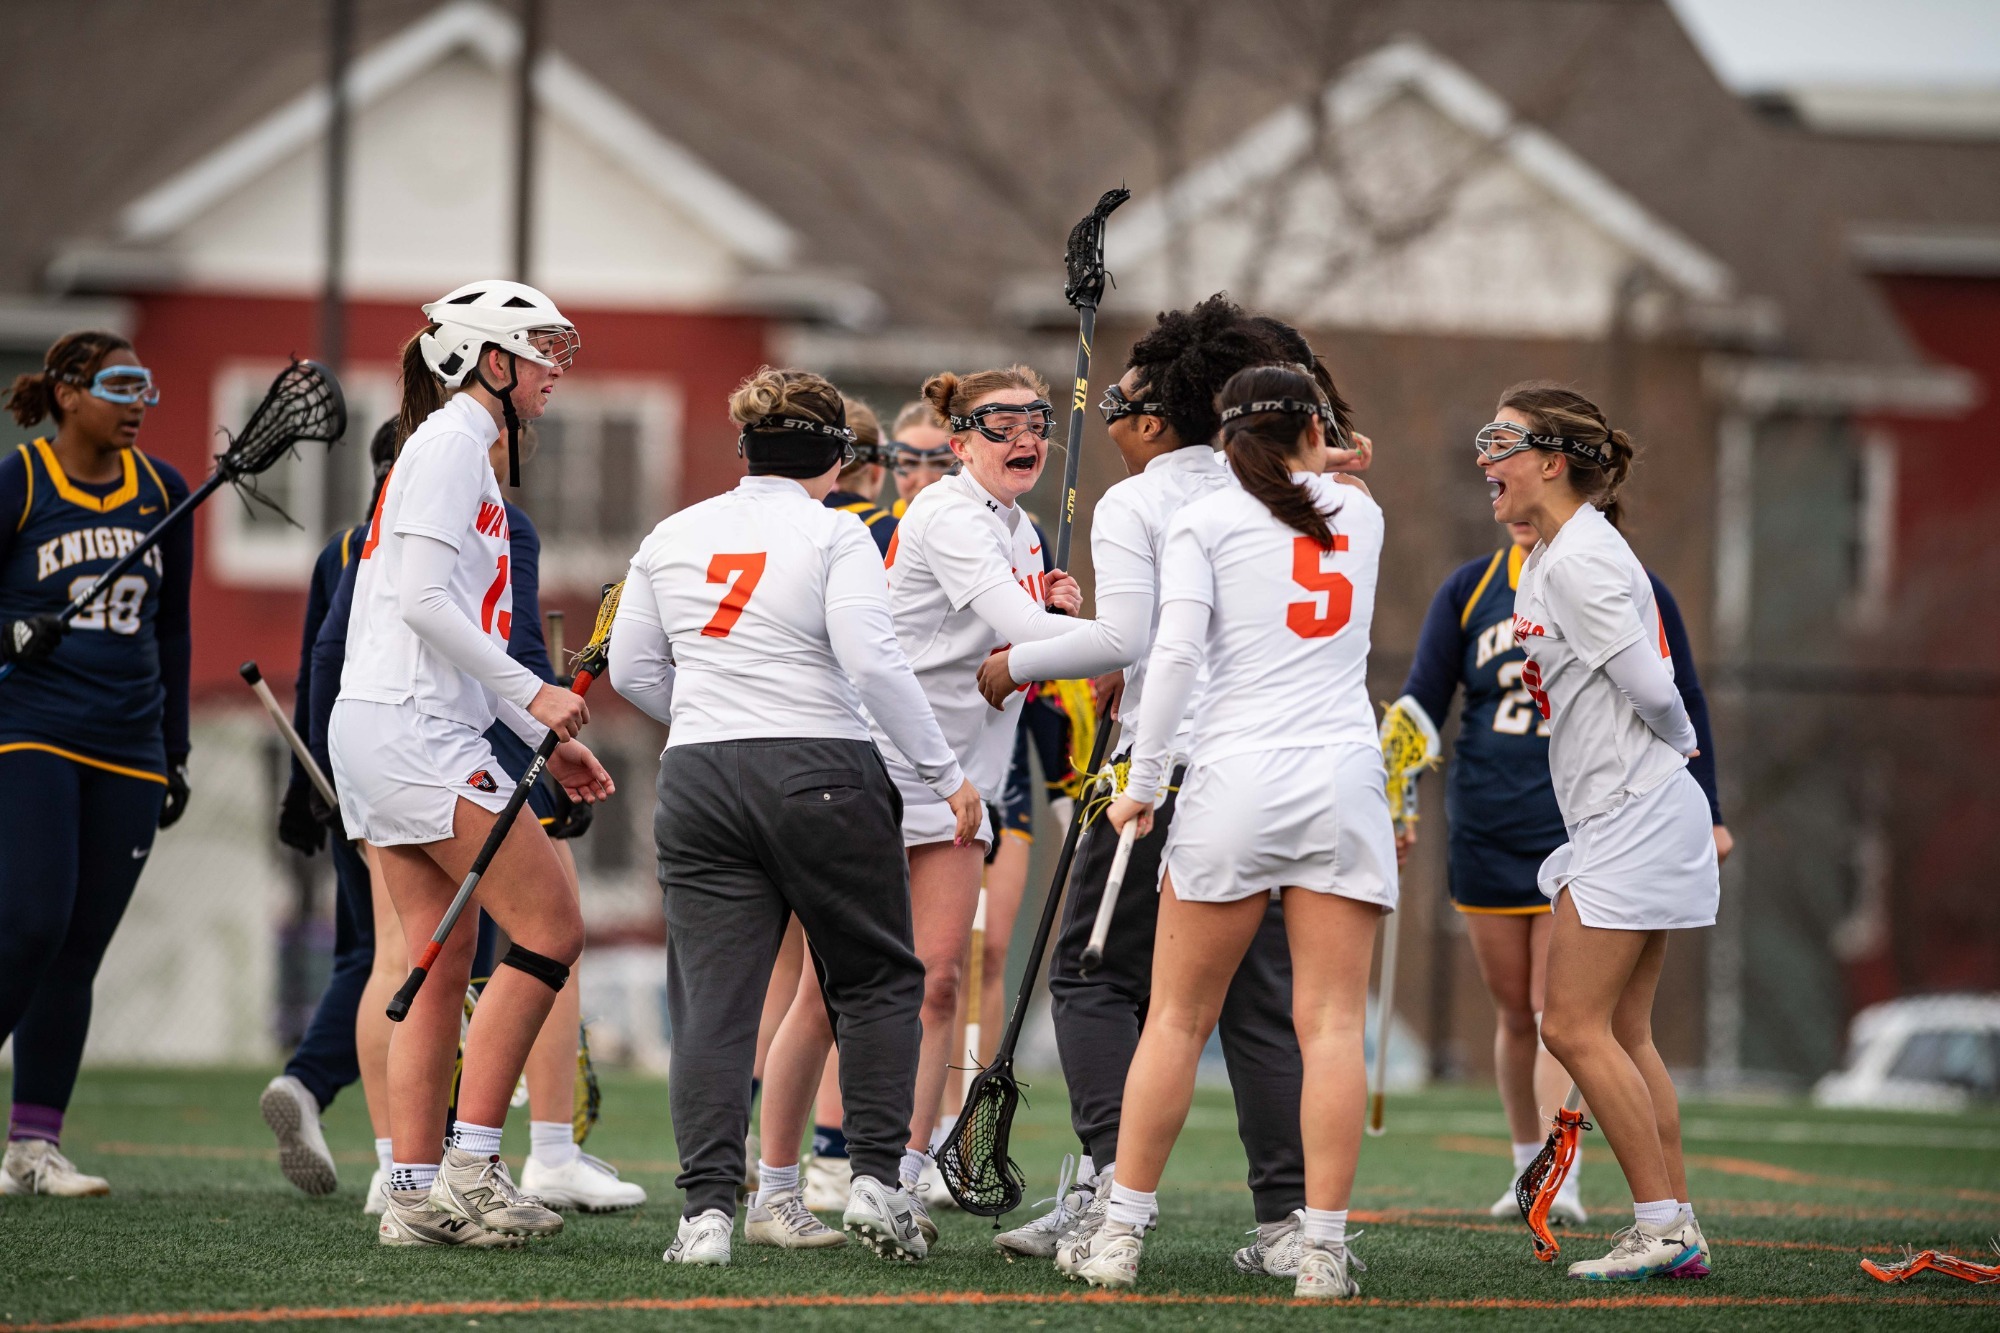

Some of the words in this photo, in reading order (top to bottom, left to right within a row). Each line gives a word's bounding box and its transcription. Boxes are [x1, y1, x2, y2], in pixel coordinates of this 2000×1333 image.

[1074, 377, 1087, 412] STX
[782, 418, 816, 431] STX
[1221, 405, 1243, 421] STX
[1251, 400, 1284, 412] STX
[1531, 434, 1565, 446] STX
[1572, 440, 1597, 458] STX
[700, 551, 767, 637] 7
[1286, 533, 1354, 639] 5
[525, 756, 546, 787] GAIT
